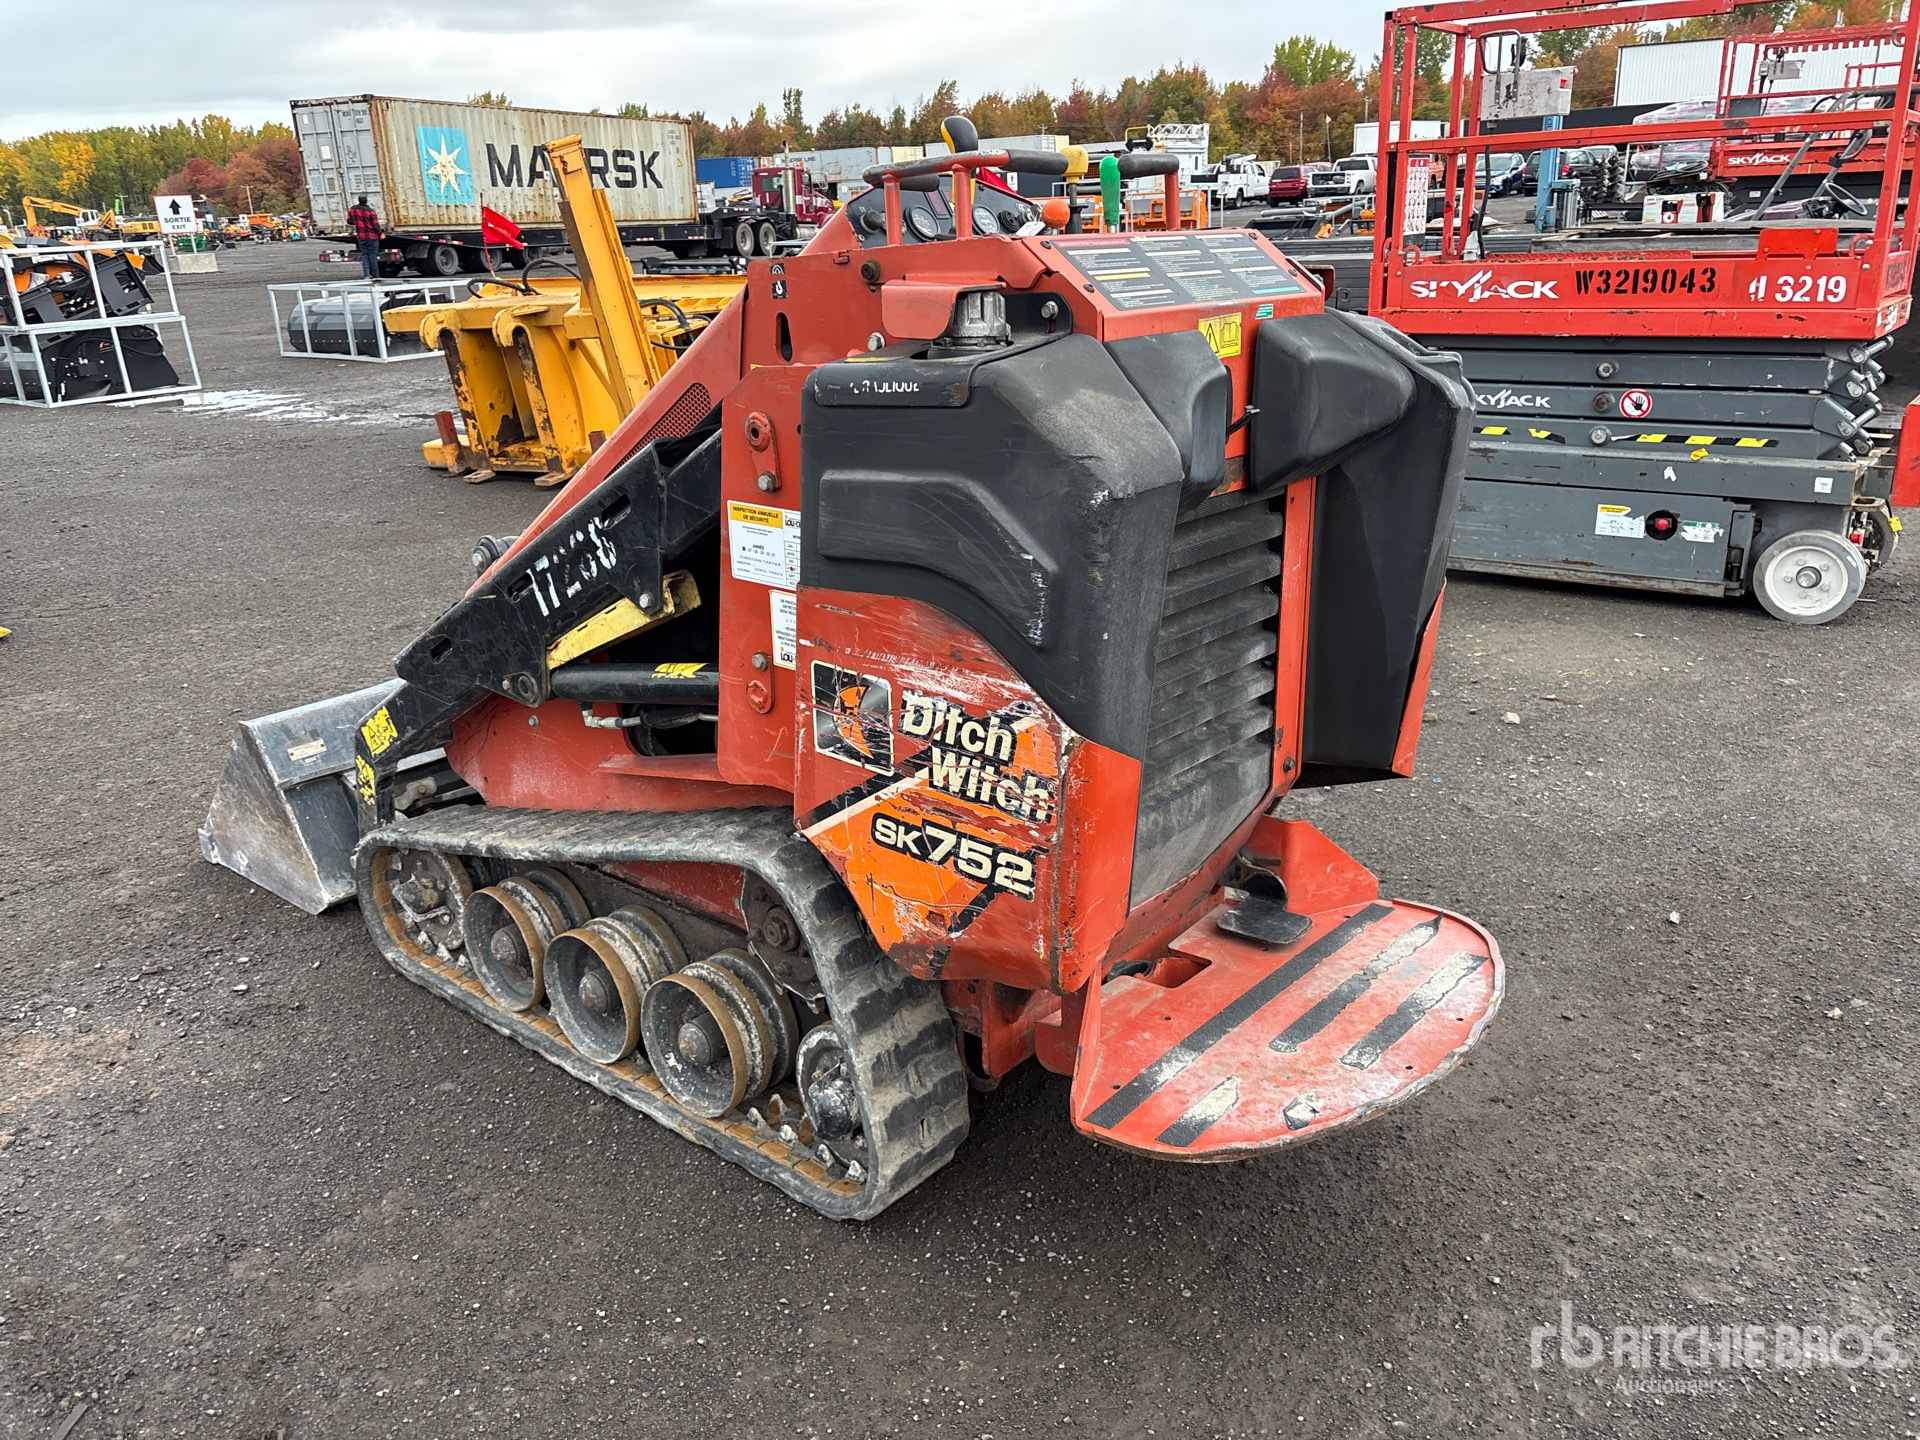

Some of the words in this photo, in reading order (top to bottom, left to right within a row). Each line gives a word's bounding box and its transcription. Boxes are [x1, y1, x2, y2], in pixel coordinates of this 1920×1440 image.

[486, 143, 663, 188] MARSK
[1728, 152, 1790, 165] SKYJACK
[1575, 267, 1716, 295] W3219043
[1774, 275, 1847, 303] 3219
[1475, 389, 1552, 408] KYJACK
[733, 506, 757, 515] INSPECTION
[757, 510, 779, 519] ANNUELLE
[902, 696, 1013, 762] Ditch
[932, 746, 1050, 821] Witch
[874, 817, 1034, 896] SK752
